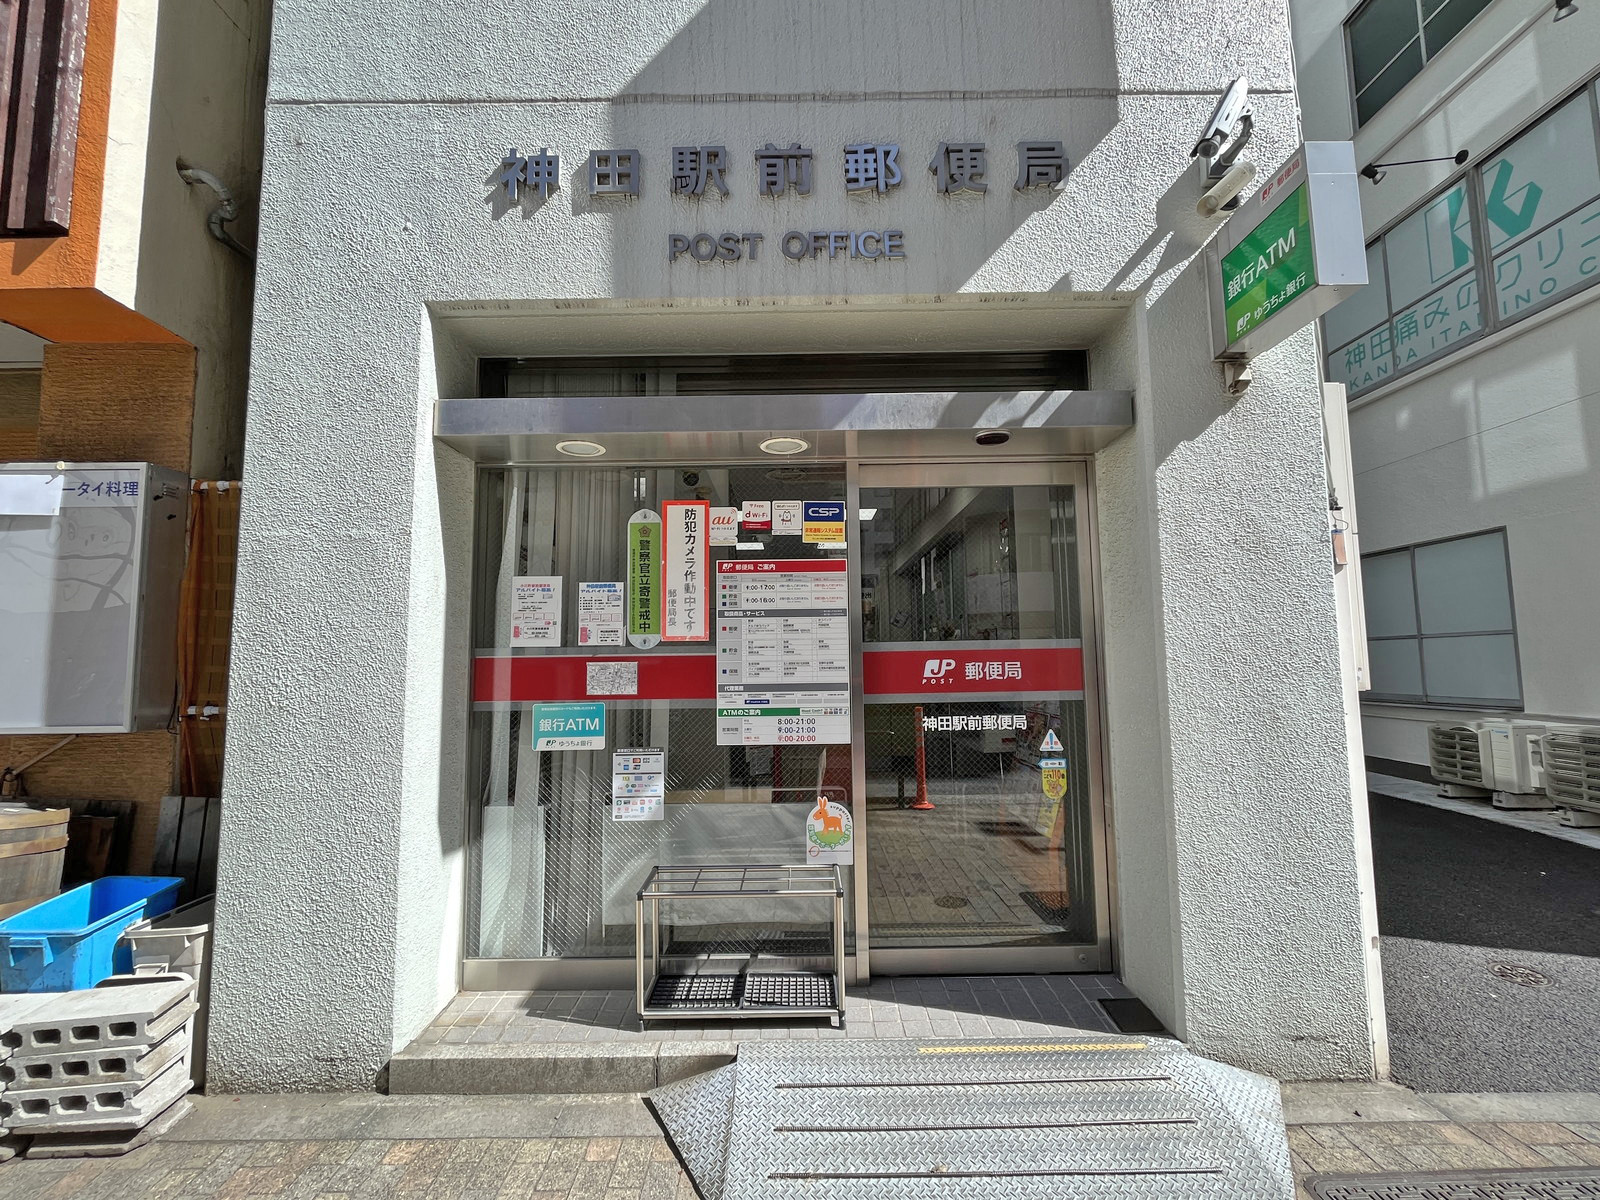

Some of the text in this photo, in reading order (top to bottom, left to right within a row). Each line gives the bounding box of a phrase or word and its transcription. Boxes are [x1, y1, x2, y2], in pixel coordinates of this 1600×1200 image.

[501, 141, 1070, 198] 神田駅前郵便局
[668, 230, 905, 261] POST OFFICE
[1227, 226, 1297, 301] 銀行ATM
[1253, 271, 1306, 320] ゆうちょ銀行
[711, 516, 735, 526] au
[808, 507, 840, 517] CSP
[639, 539, 651, 632] 警察官立寄警戒中
[683, 508, 697, 632] 防犯カメラ作動中です
[667, 589, 678, 627] 郵便局長
[965, 661, 1023, 681] 郵便局
[538, 717, 600, 732] 銀行ATM
[922, 714, 1028, 732] 神田駅前郵便局
